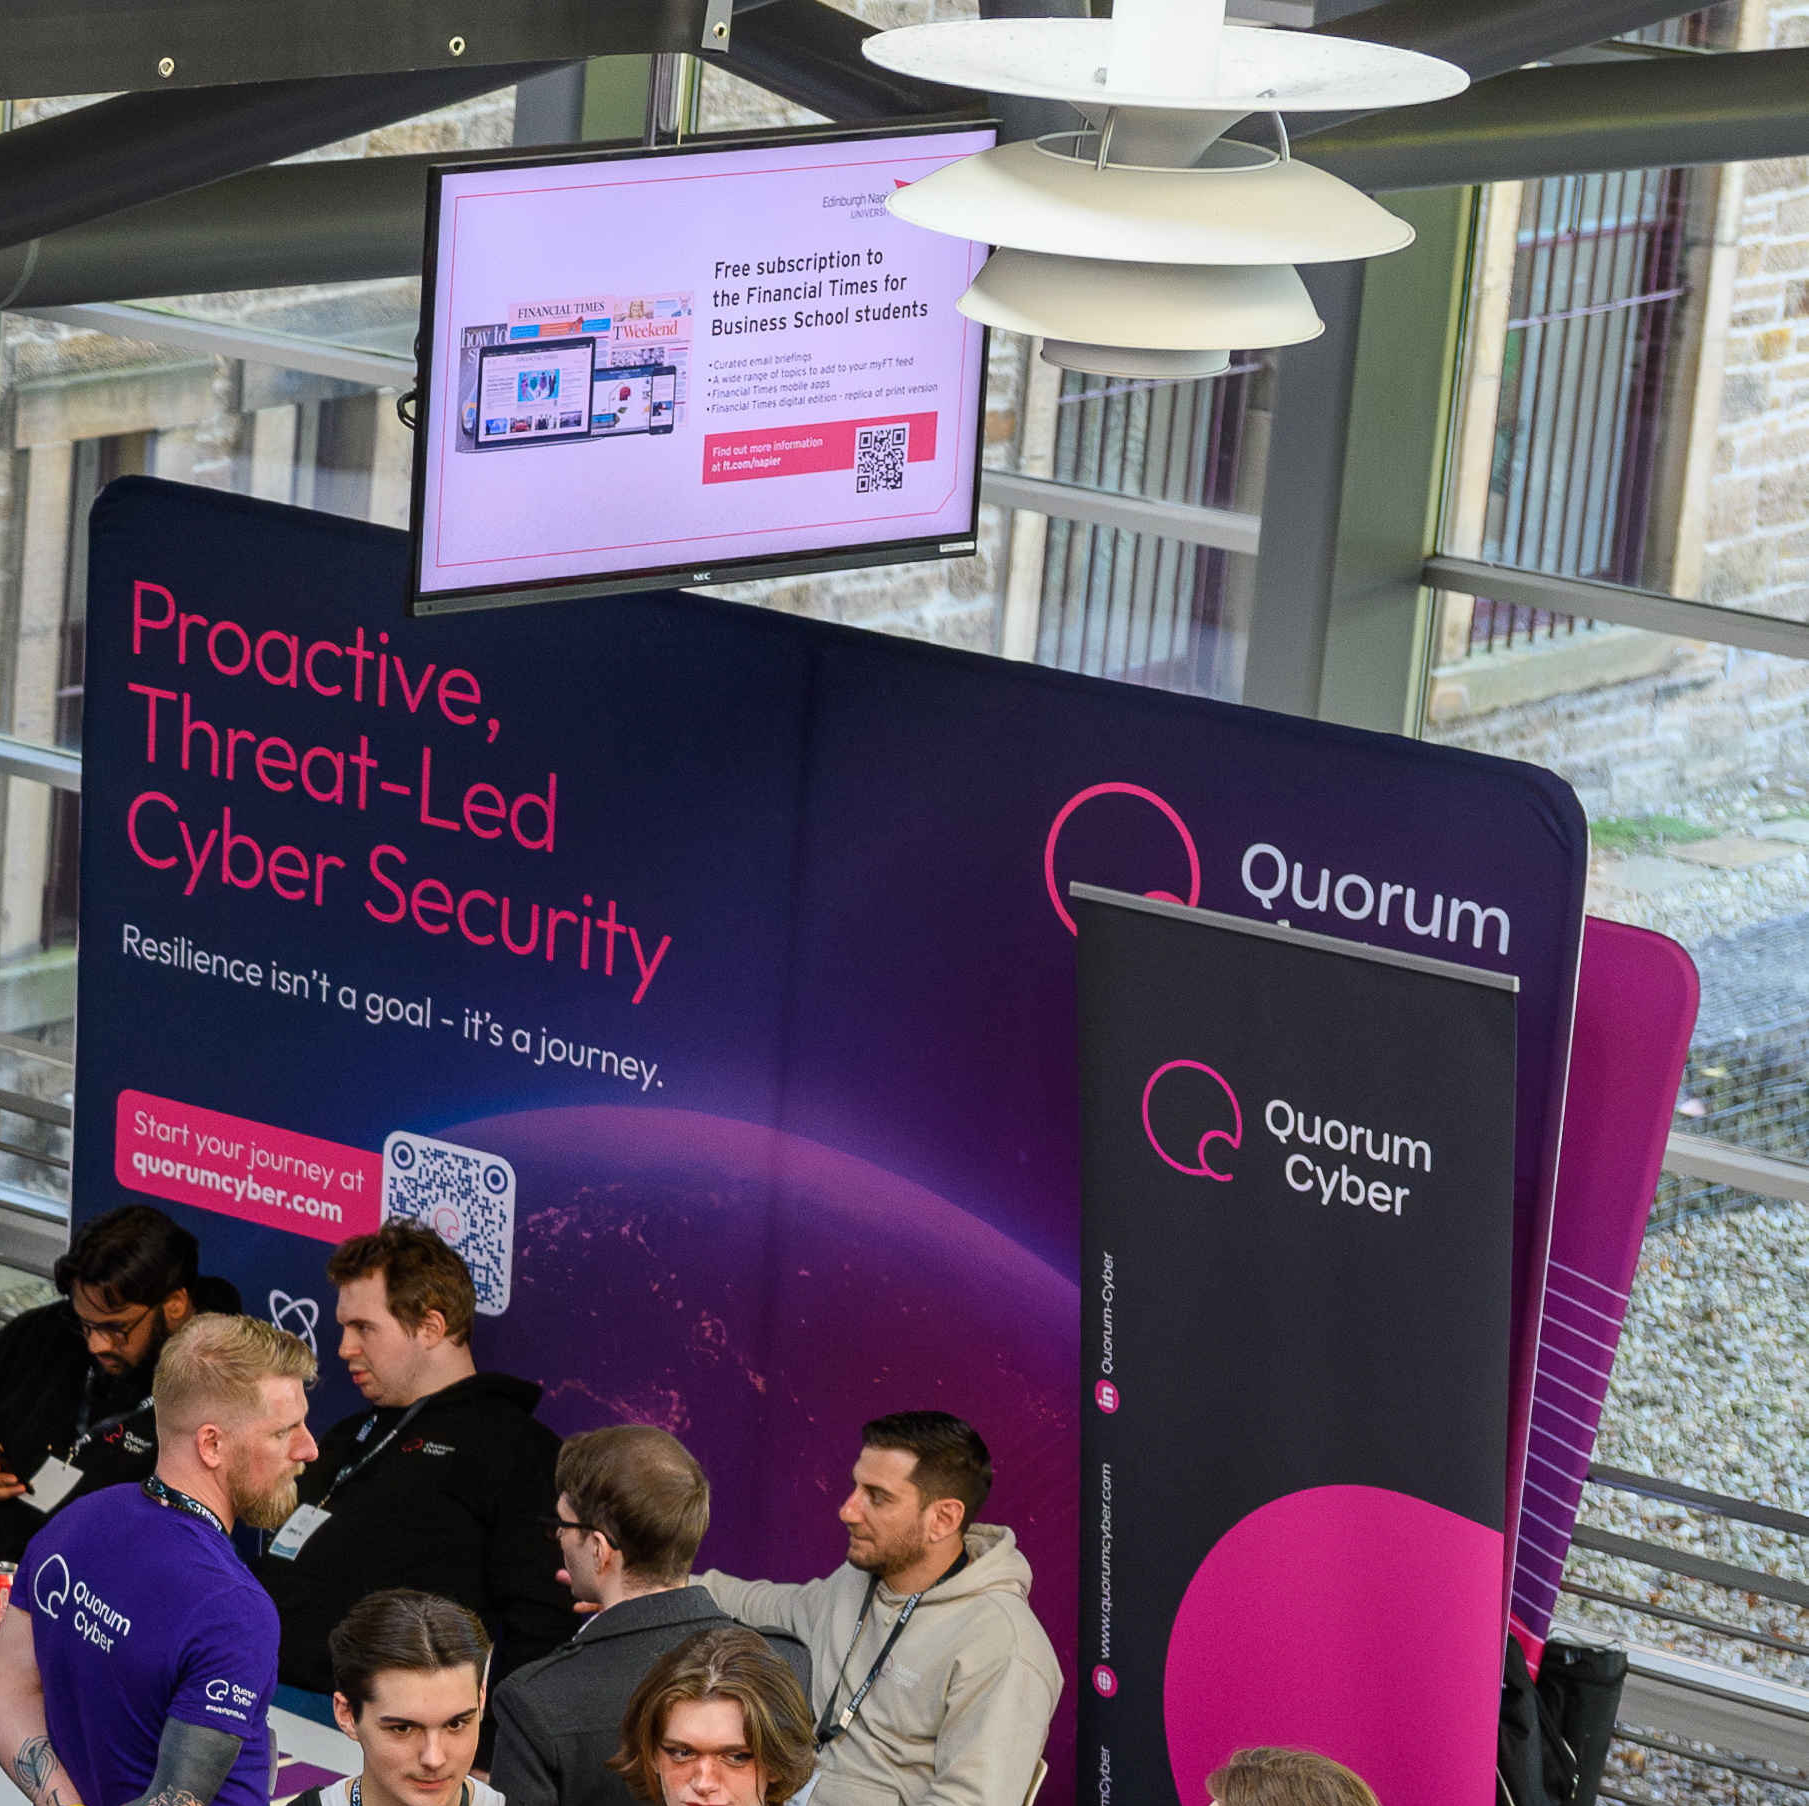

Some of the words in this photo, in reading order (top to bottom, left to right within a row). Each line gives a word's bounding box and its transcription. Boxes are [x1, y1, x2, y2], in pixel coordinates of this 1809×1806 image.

[822, 195, 867, 208] Edinburgh
[714, 262, 750, 279] Free
[757, 250, 861, 275] subscription
[867, 248, 883, 265] to
[518, 302, 572, 319] FINANCIAL
[575, 301, 605, 314] TIMES
[713, 290, 740, 308] the
[747, 281, 822, 304] Financial
[829, 279, 878, 297] Times
[884, 274, 907, 291] for
[493, 322, 508, 345] to
[711, 316, 787, 336] Business
[794, 307, 849, 329] School
[855, 301, 928, 323] students
[713, 375, 720, 384] A
[722, 371, 741, 383] wide
[744, 371, 768, 383] range
[770, 368, 779, 379] of
[781, 366, 807, 380] topics
[809, 366, 817, 376] to
[820, 363, 836, 374] add
[838, 363, 847, 373] to
[849, 362, 867, 374] your
[869, 358, 893, 371] myFT
[895, 356, 914, 367] feed
[714, 358, 747, 370] Curated
[750, 354, 773, 366] email
[775, 353, 812, 365] briefings
[711, 400, 750, 414] Financial
[752, 398, 777, 410] Times
[779, 394, 805, 408] digital
[807, 392, 837, 405] edition
[845, 388, 873, 401] replica
[875, 386, 884, 397] of
[885, 385, 906, 398] print
[908, 382, 938, 395] version
[712, 386, 751, 399] Financial
[753, 384, 777, 395] Times
[779, 380, 808, 393] mobile
[810, 380, 831, 392] apps
[712, 462, 721, 472] at
[723, 456, 782, 472] ft.com/napier
[713, 444, 732, 456] Find
[733, 444, 748, 456] out
[750, 443, 772, 455] more
[774, 437, 823, 451] information
[693, 572, 711, 581] NEC
[133, 580, 500, 743] Proactive,
[128, 682, 557, 853] Threat-Led
[127, 791, 345, 896] Cyber
[364, 845, 673, 1005] Security
[1241, 842, 1511, 955] Quorum
[122, 924, 263, 987] Resilience
[270, 961, 331, 1003] isn't
[339, 984, 356, 1010] a
[365, 991, 431, 1030] goal
[463, 1008, 503, 1047] it's
[511, 1027, 530, 1054] a
[533, 1026, 664, 1093] journey.
[133, 1110, 190, 1146] Start
[194, 1127, 247, 1162] your
[247, 1138, 334, 1190] journey
[340, 1167, 365, 1193] at
[1265, 1099, 1432, 1173] Quorum
[132, 1151, 343, 1224] quorumcyber.com
[1285, 1154, 1410, 1216] Cyber
[1101, 1250, 1115, 1375] Quorum-Cyber
[1099, 1463, 1113, 1659] www.quorumcyber.com
[74, 1582, 131, 1637] Quorum
[74, 1611, 115, 1654] Cyber
